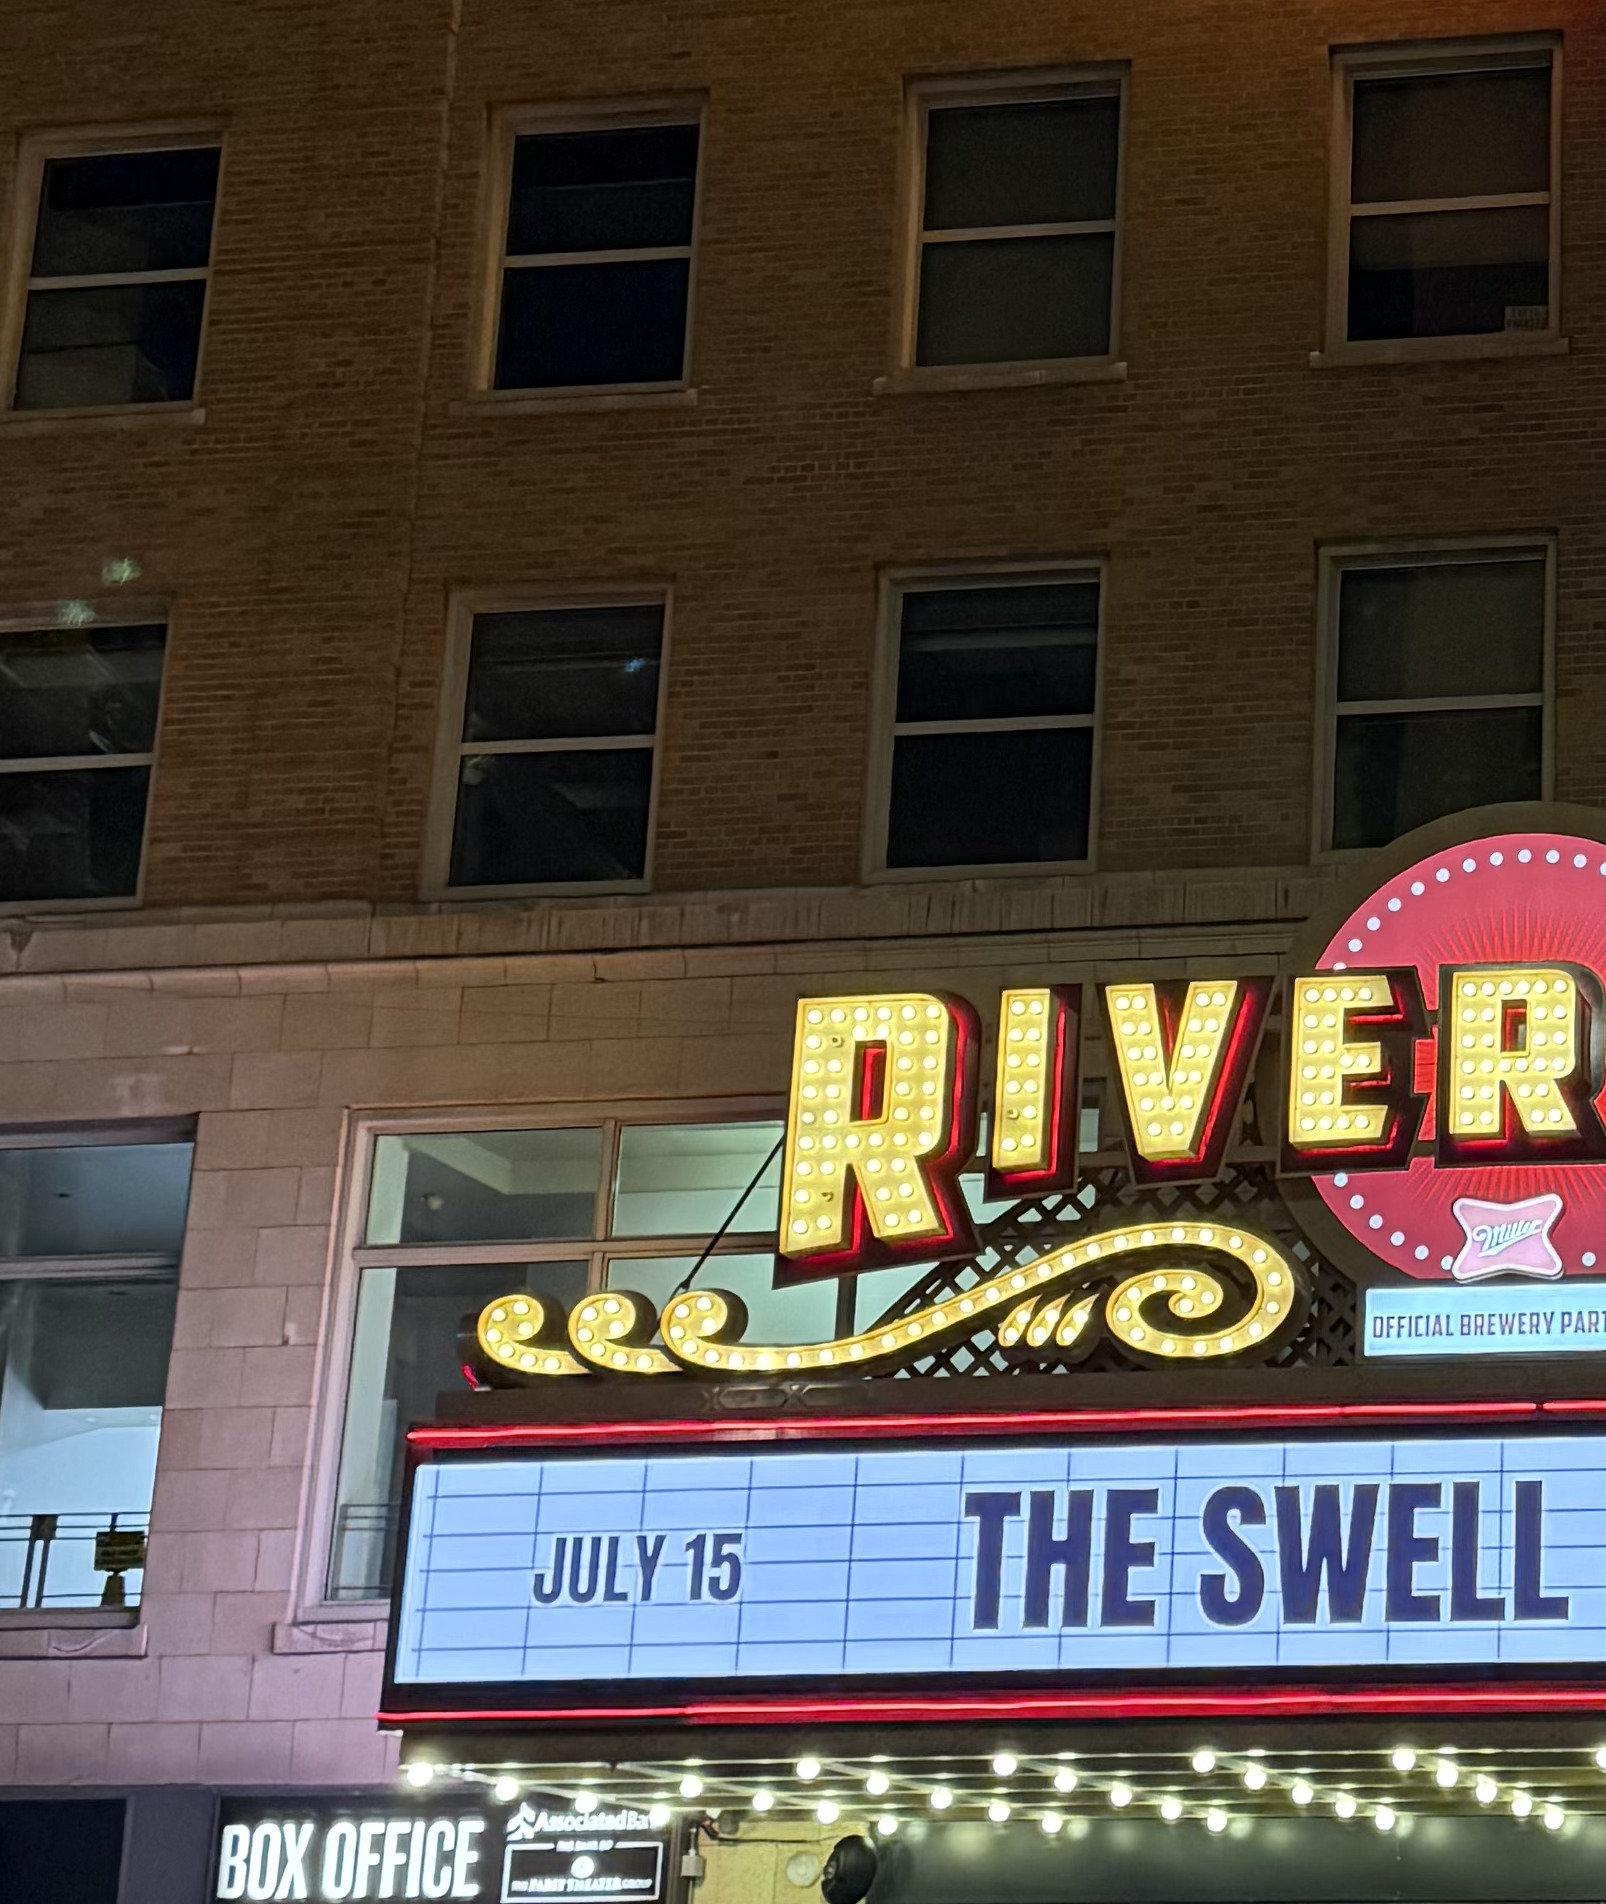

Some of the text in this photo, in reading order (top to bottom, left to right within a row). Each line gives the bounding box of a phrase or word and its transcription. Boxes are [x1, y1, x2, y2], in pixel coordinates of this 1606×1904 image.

[1471, 1219, 1543, 1257] Miller
[1372, 1314, 1454, 1339] OFFICIAL
[1460, 1311, 1555, 1336] BREWERY
[533, 1536, 666, 1604] JULY
[684, 1532, 743, 1602] 15
[962, 1486, 1160, 1631] THE
[1198, 1479, 1570, 1627] SWELL
[217, 1819, 486, 1901] BOX OFFICE
